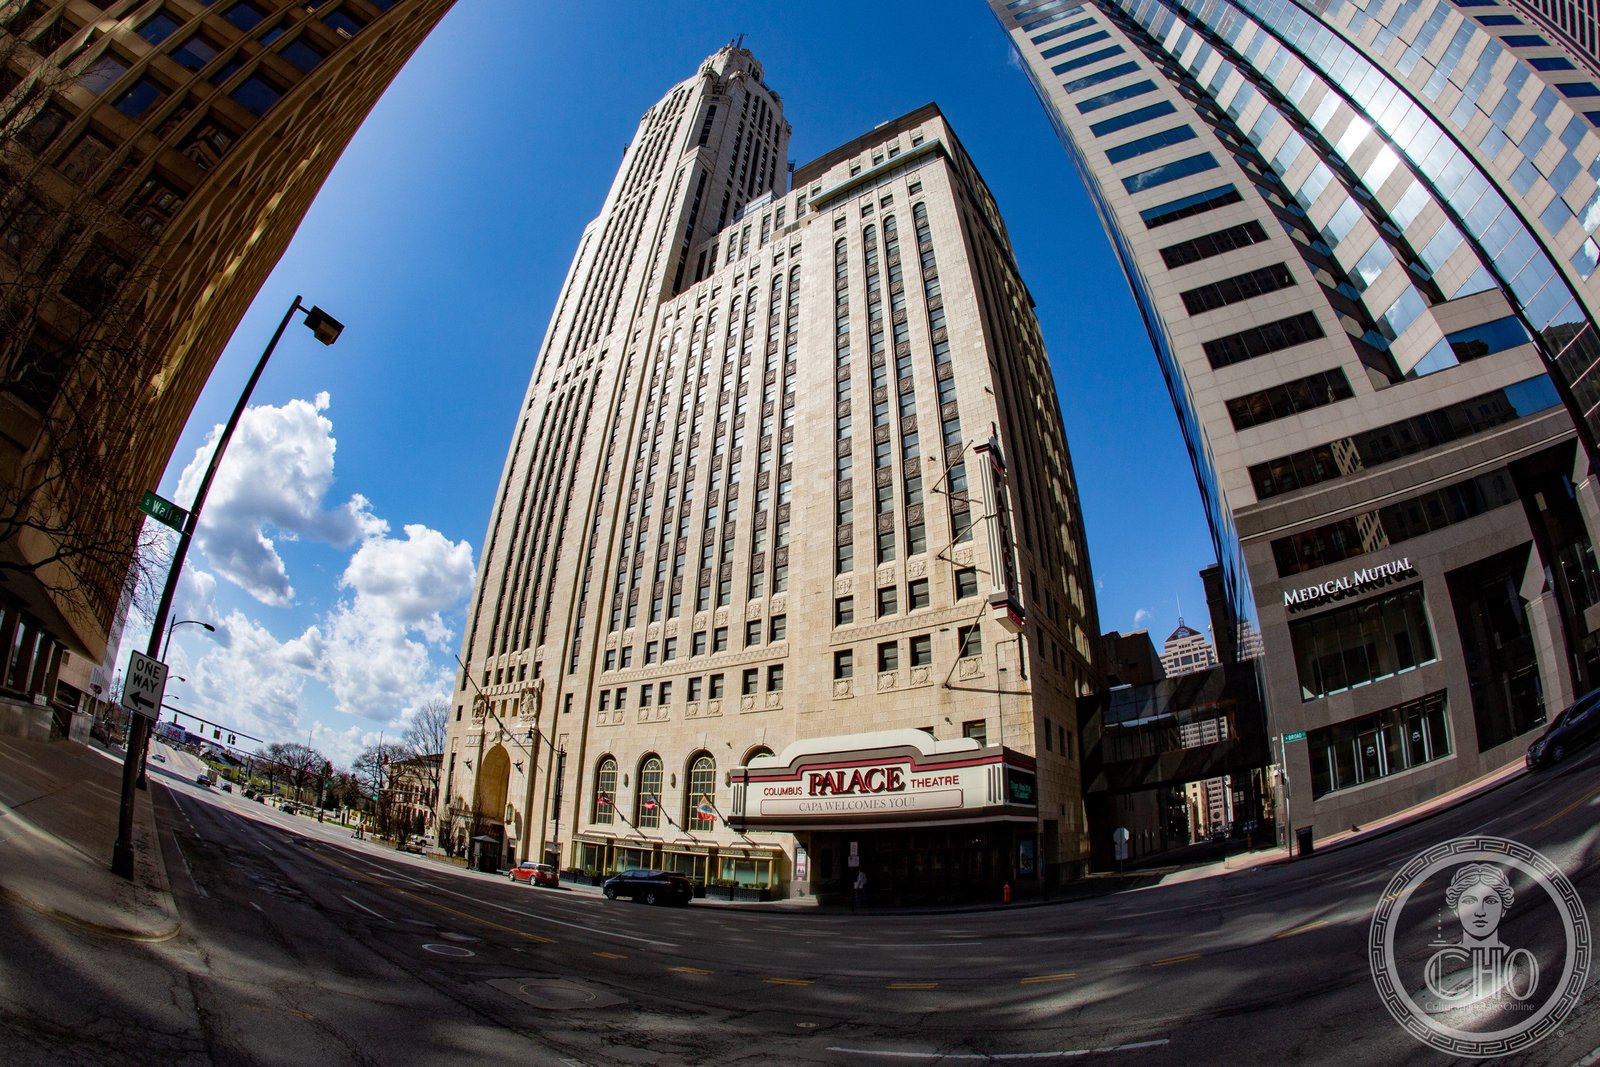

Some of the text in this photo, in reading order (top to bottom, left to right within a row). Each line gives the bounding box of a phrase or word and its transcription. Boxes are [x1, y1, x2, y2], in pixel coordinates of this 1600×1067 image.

[152, 500, 174, 521] Wall
[137, 659, 161, 680] ONE
[133, 673, 159, 693] WAY
[763, 767, 960, 797] COLUMBUS PALACE THEATRE
[799, 797, 915, 813] CAPA WELCOMES YOU!
